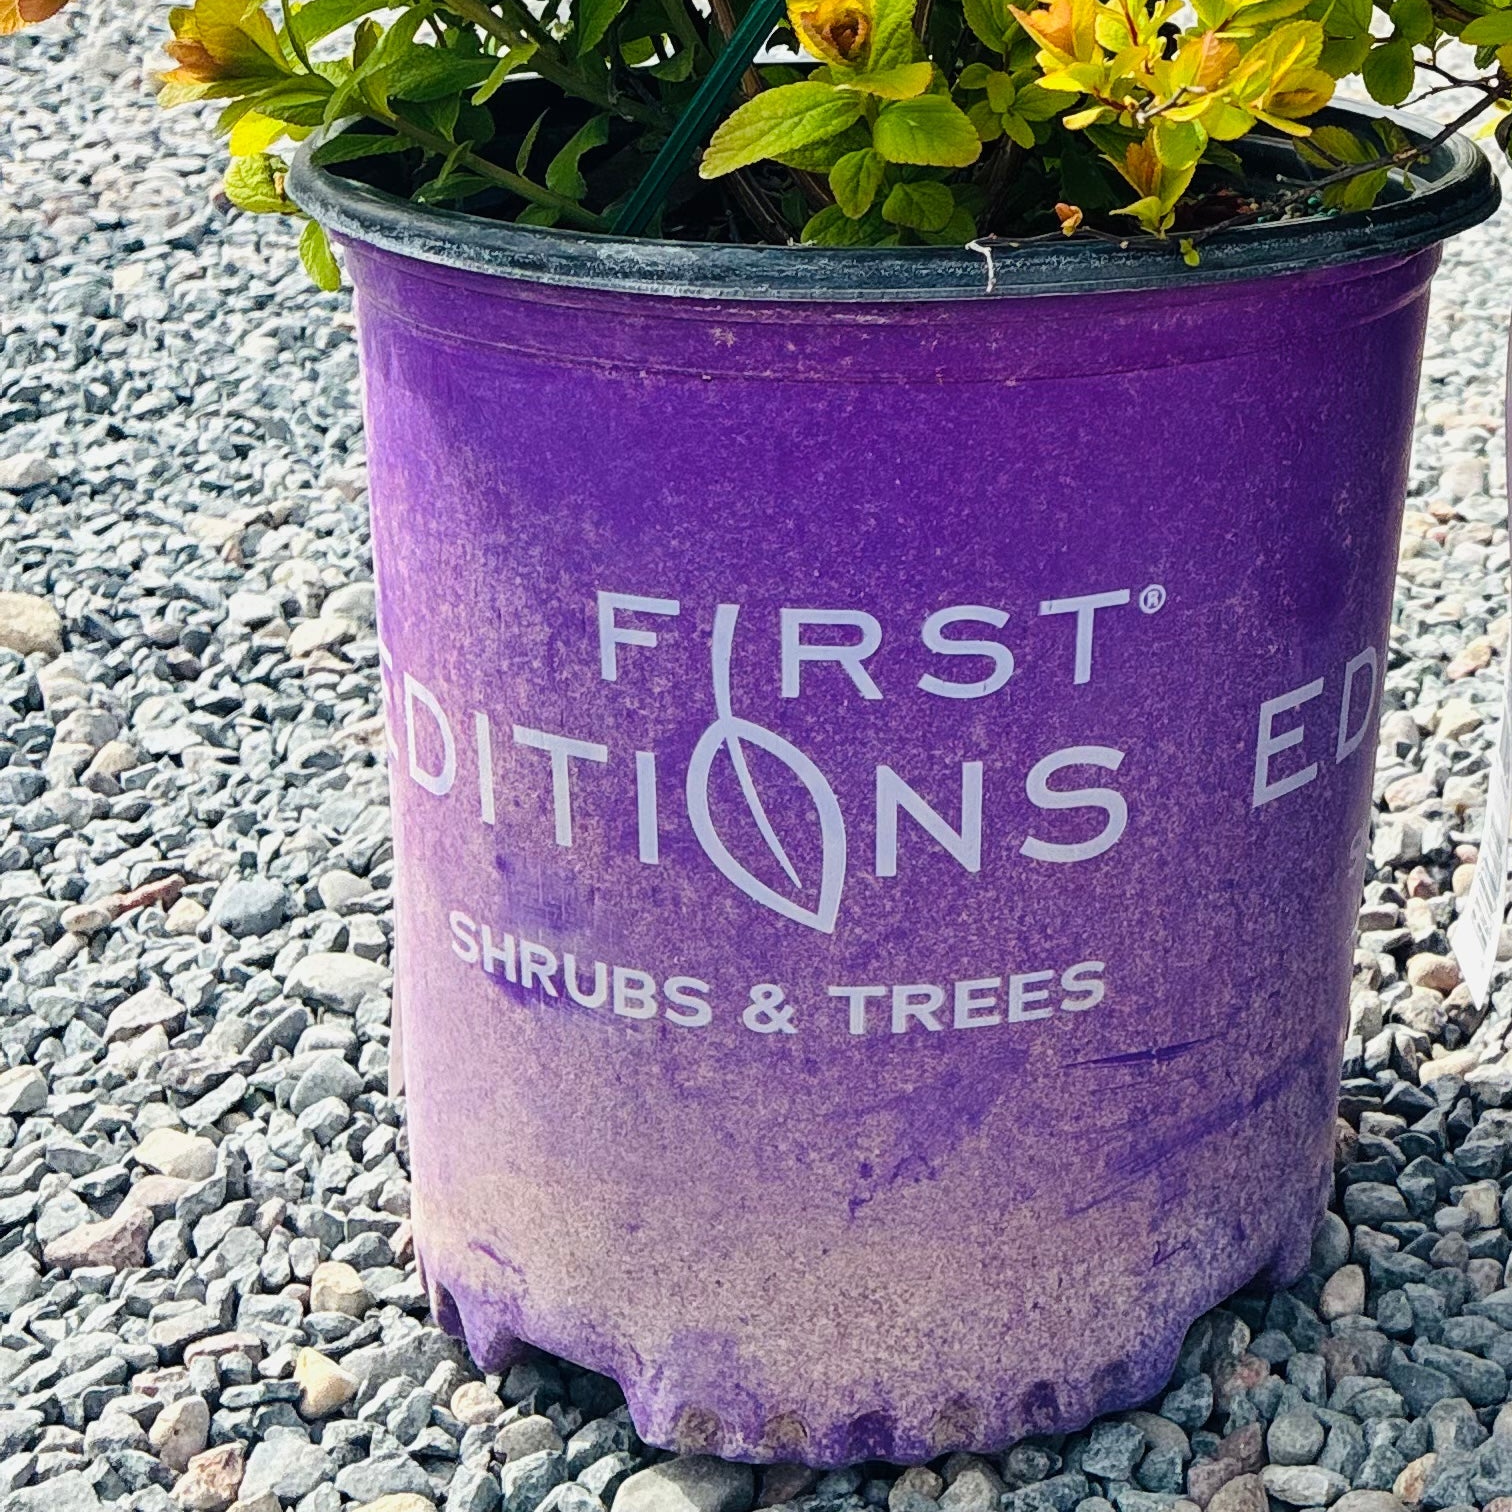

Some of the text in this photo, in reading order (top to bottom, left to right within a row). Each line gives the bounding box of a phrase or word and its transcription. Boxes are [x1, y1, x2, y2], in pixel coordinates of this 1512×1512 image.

[448, 911, 1106, 1036] SHRUBS & TREES
